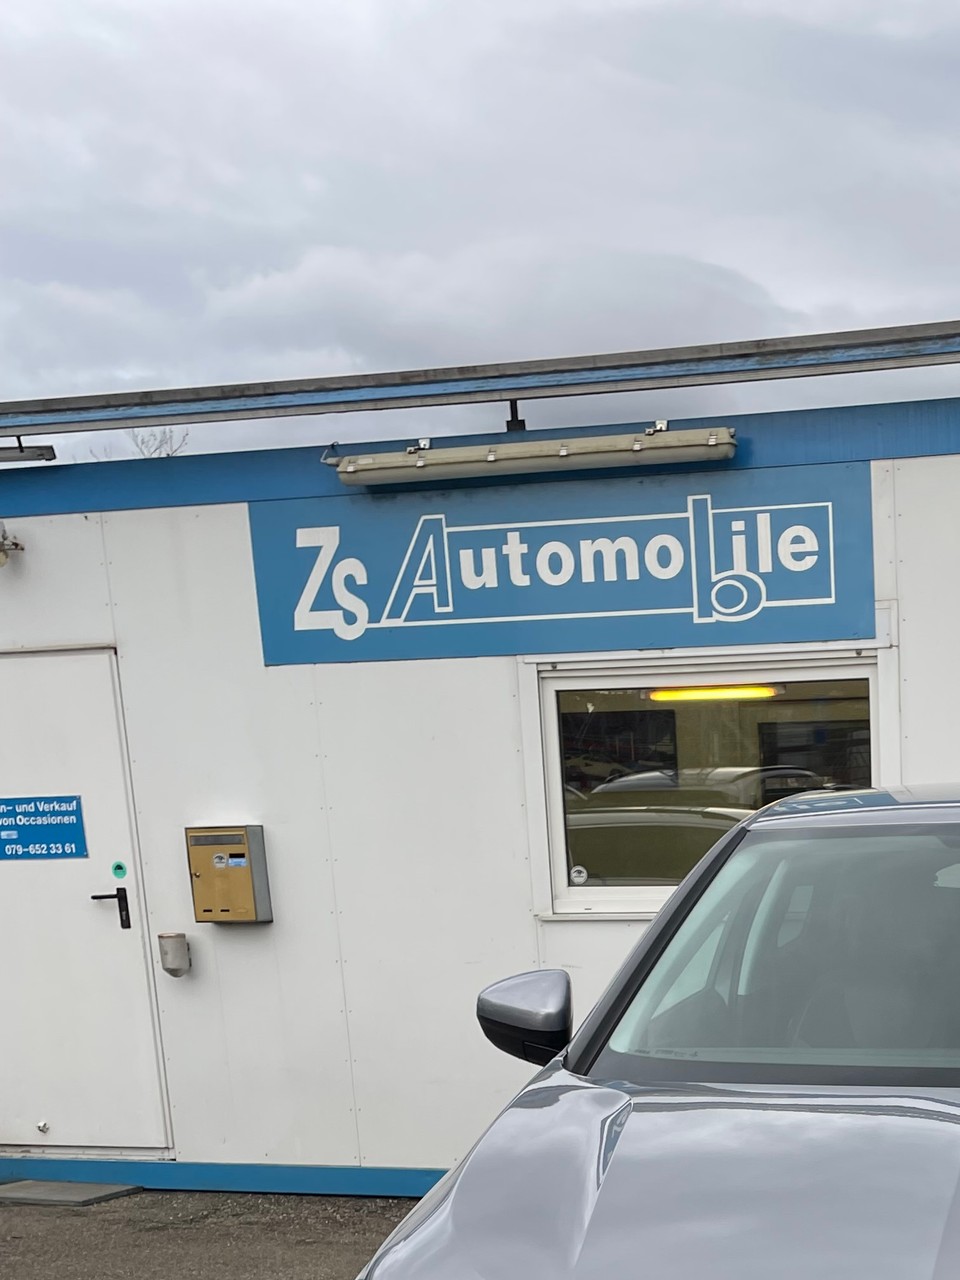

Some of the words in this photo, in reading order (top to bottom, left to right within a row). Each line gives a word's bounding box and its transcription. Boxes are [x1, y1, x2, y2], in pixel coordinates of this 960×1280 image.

[380, 494, 820, 625] Automobile
[15, 802, 35, 813] und
[36, 800, 77, 812] Verkauf
[16, 813, 77, 826] Occasionen
[5, 843, 48, 855] 079-652
[49, 843, 63, 854] 33
[64, 843, 76, 854] 61
